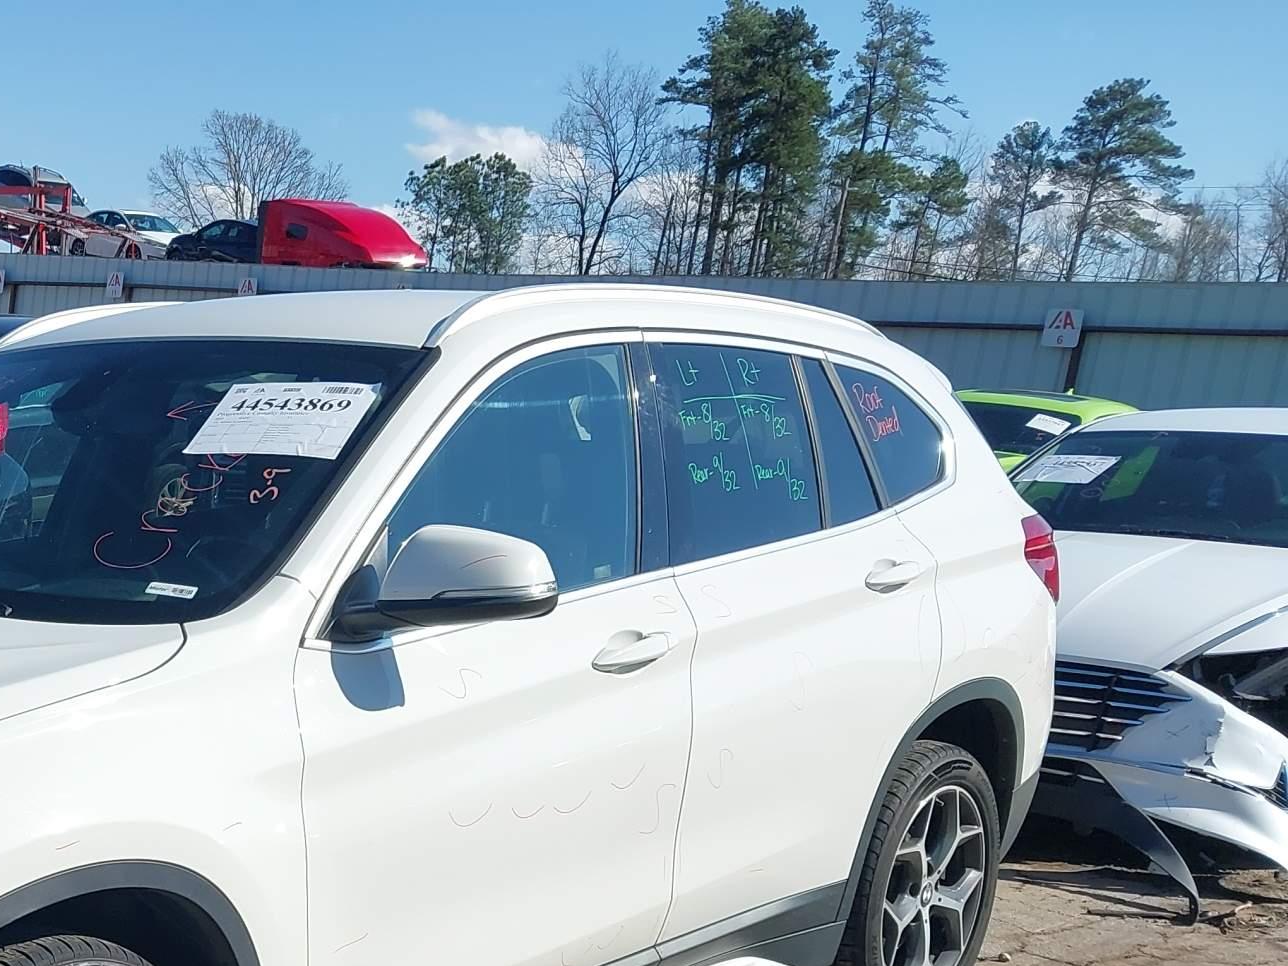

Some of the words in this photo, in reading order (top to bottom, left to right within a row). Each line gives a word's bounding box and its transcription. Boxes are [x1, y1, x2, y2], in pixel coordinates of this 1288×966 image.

[1056, 335, 1064, 345] 6
[675, 360, 700, 386] Lt
[737, 358, 761, 388] Rt
[231, 398, 352, 413] 44543869
